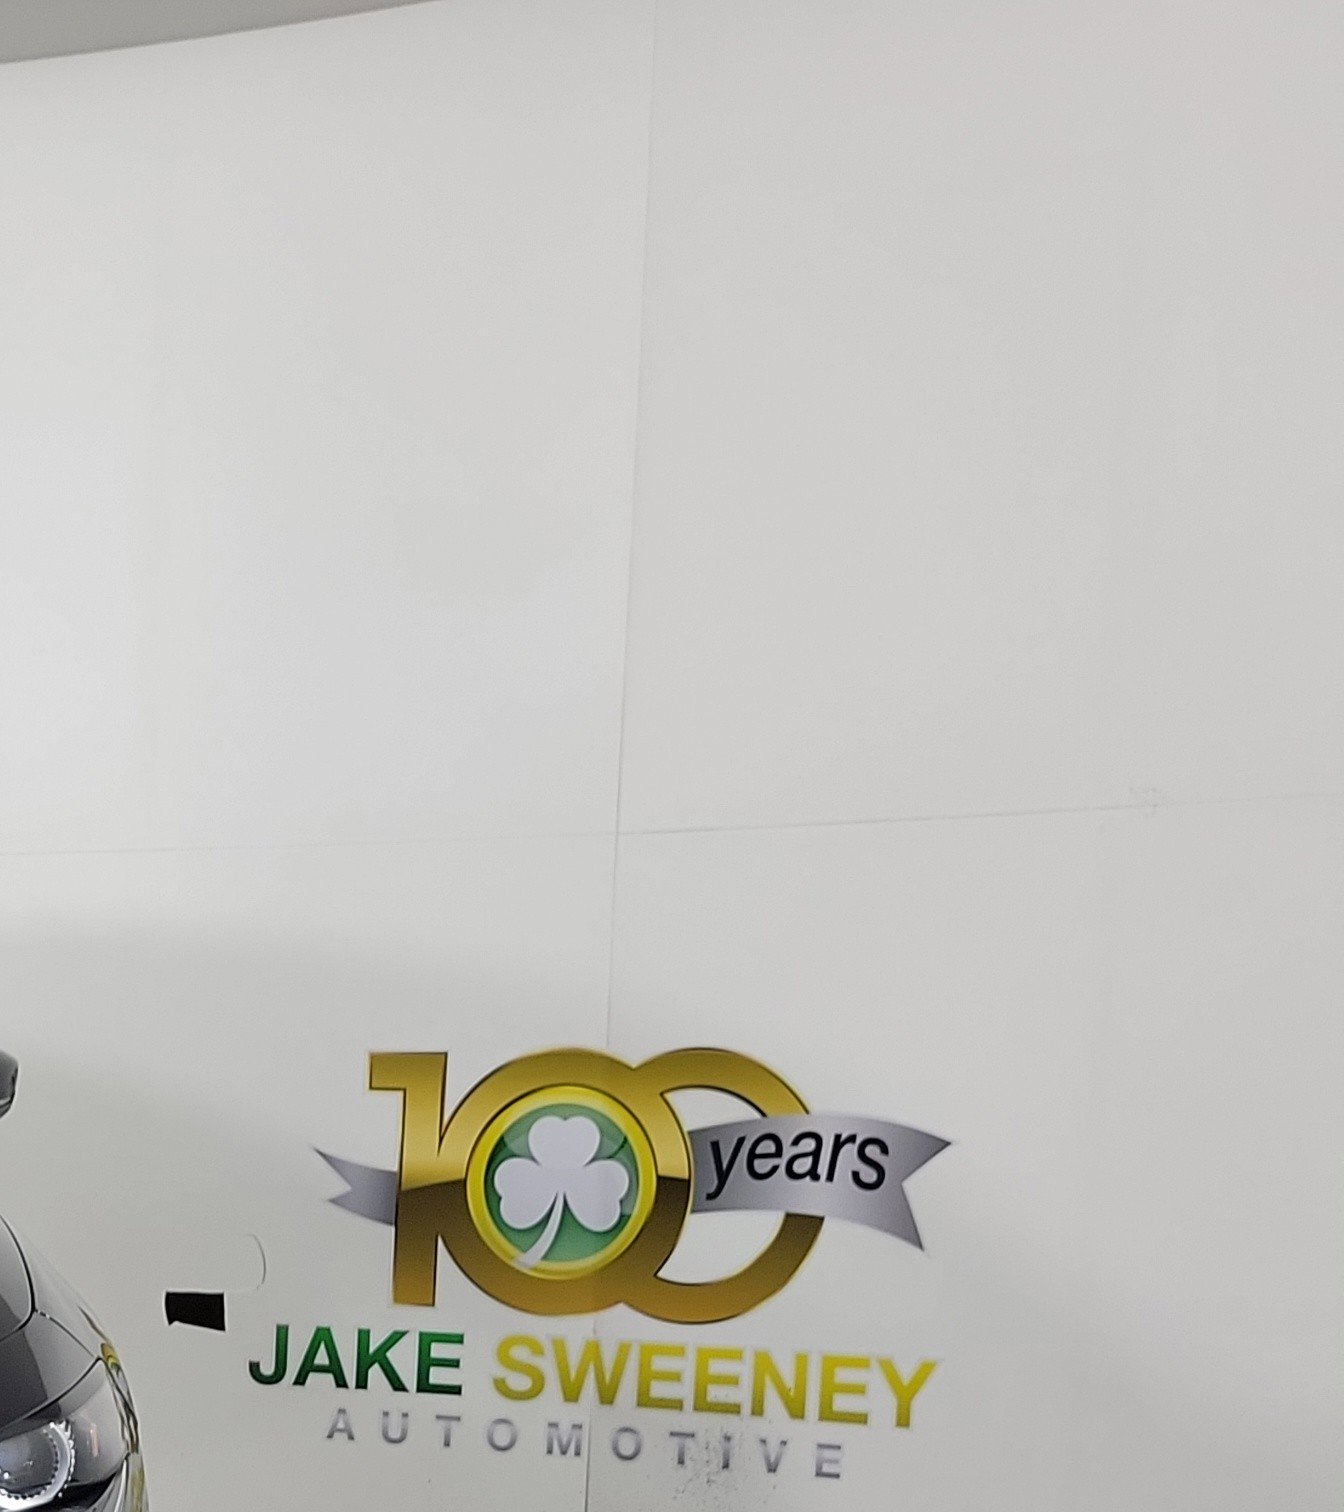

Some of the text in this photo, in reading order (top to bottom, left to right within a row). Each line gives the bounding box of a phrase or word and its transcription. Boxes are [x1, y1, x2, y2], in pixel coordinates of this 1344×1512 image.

[368, 1047, 890, 1324] 100 years
[247, 1324, 937, 1430] JAKE SWEENEY
[326, 1407, 843, 1480] AUTOMOTIVE
